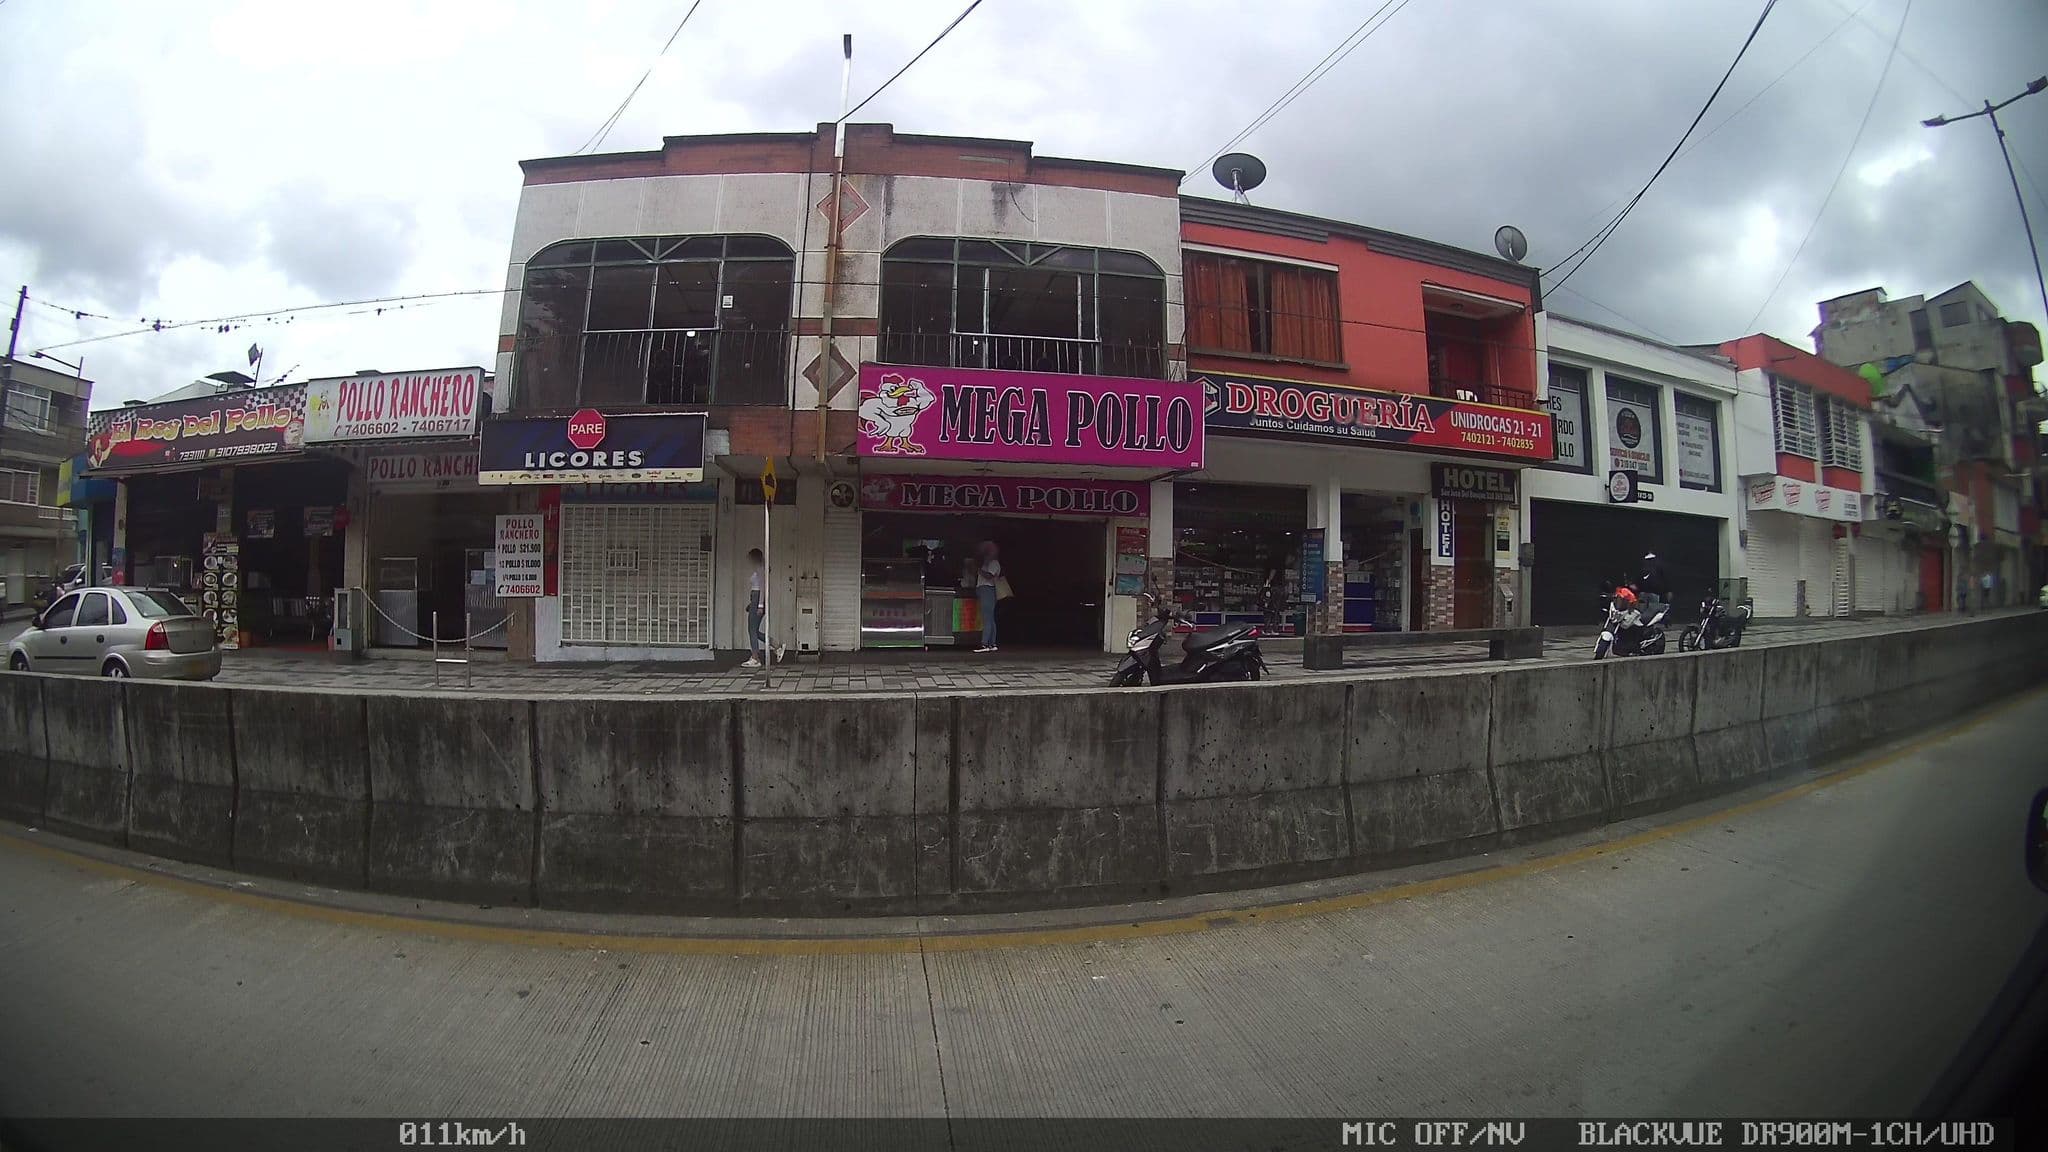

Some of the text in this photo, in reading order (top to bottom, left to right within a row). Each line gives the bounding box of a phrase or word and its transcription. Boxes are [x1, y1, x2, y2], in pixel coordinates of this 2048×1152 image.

[337, 373, 475, 423] POLLO RANCHERO
[1225, 381, 1436, 433] DROGUERÍA
[110, 403, 292, 443] El Rey Del Pollo
[345, 421, 399, 436] 7406602
[411, 418, 471, 434] 7406717
[570, 422, 603, 435] PARE
[939, 384, 1194, 454] MEGA POLLO
[1249, 417, 1377, 438] Juntos Cuidamos su Salud
[1450, 410, 1512, 434] UNIDROGAS
[1513, 419, 1525, 436] 21
[1460, 431, 1496, 446] 7402121
[1501, 436, 1535, 450] 7402835
[370, 458, 417, 479] POLLO
[525, 450, 644, 468] LICORES
[1442, 467, 1511, 492] HOTEL
[900, 482, 1007, 509] MEGA
[1017, 486, 1139, 513] POLLO
[506, 519, 533, 528] POLLO
[1440, 500, 1451, 556] HOTEL
[500, 530, 539, 540] RANCHERO
[501, 544, 516, 553] POLLO
[505, 560, 520, 568] POLLO
[506, 585, 540, 593] 7406602
